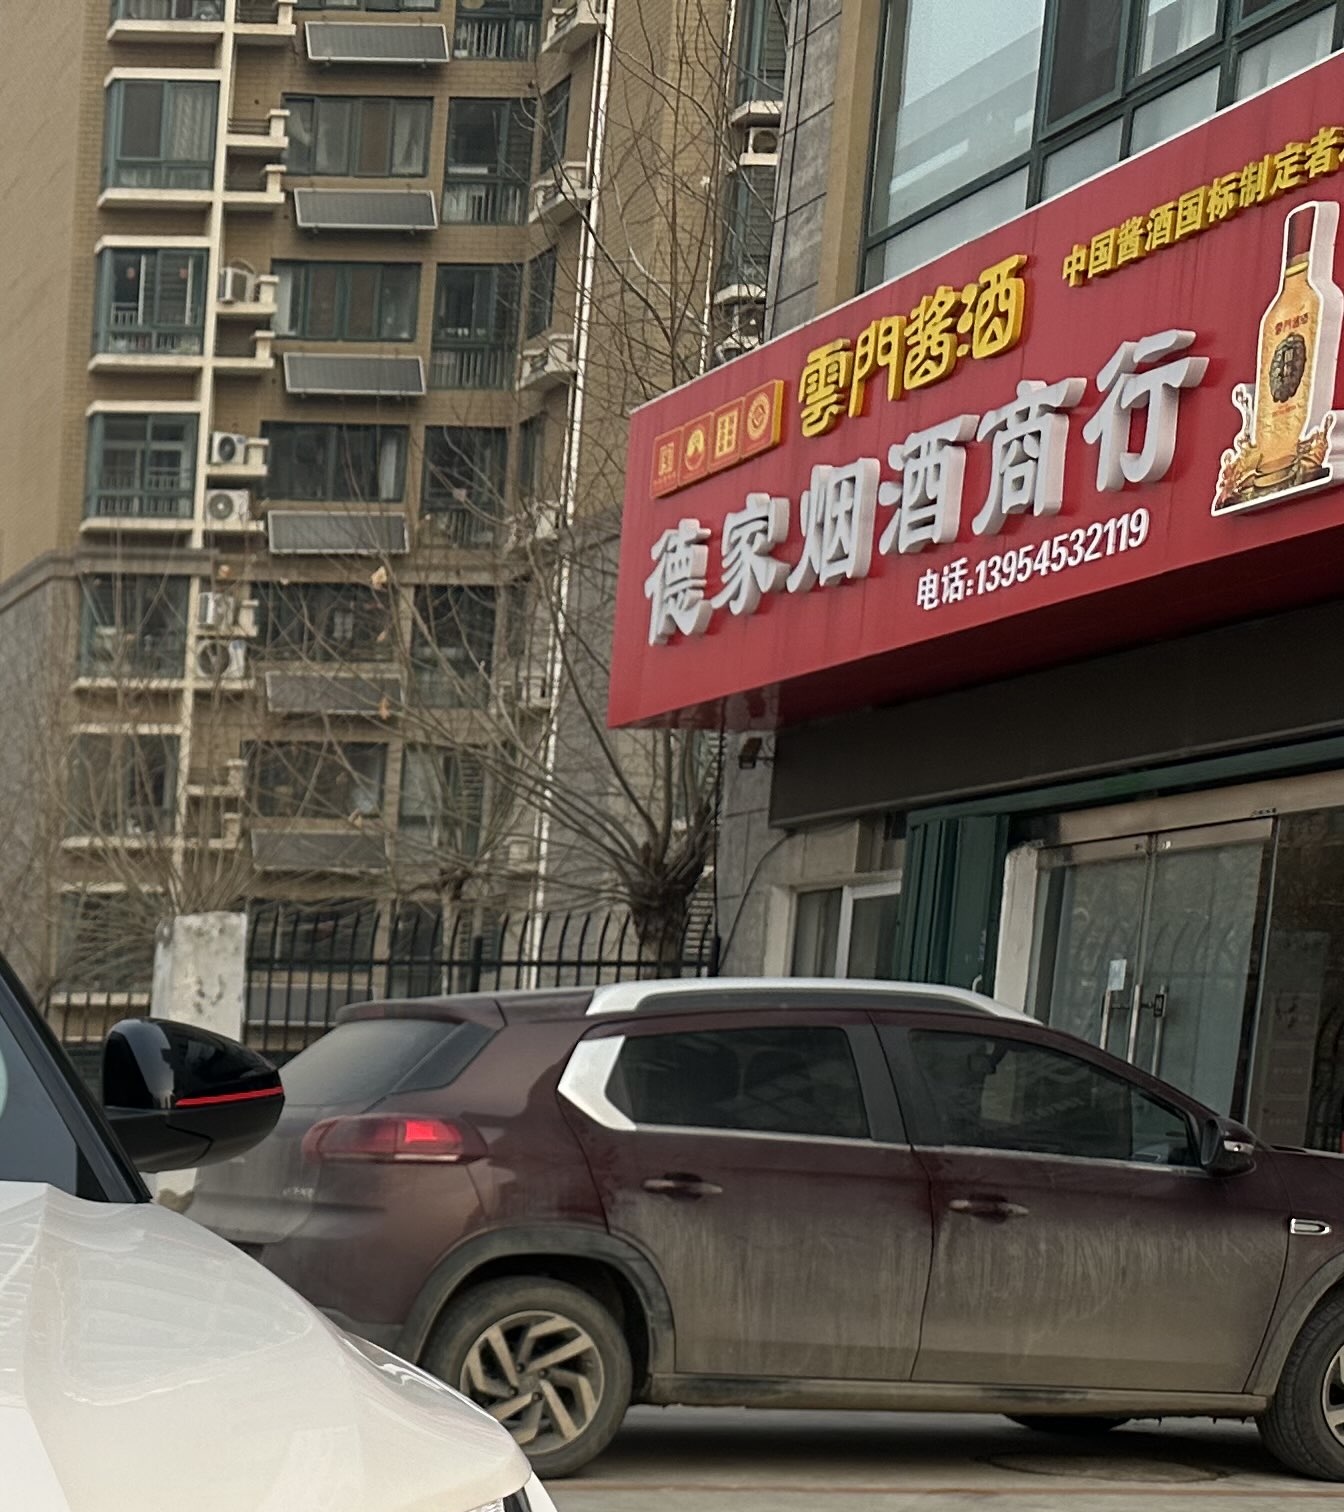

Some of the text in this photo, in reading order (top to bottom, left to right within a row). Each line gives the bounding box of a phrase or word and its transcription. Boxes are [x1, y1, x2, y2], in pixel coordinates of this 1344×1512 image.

[1062, 126, 1344, 288] 中国酱酒国标制定者
[644, 329, 1209, 646] 德家烟酒商行
